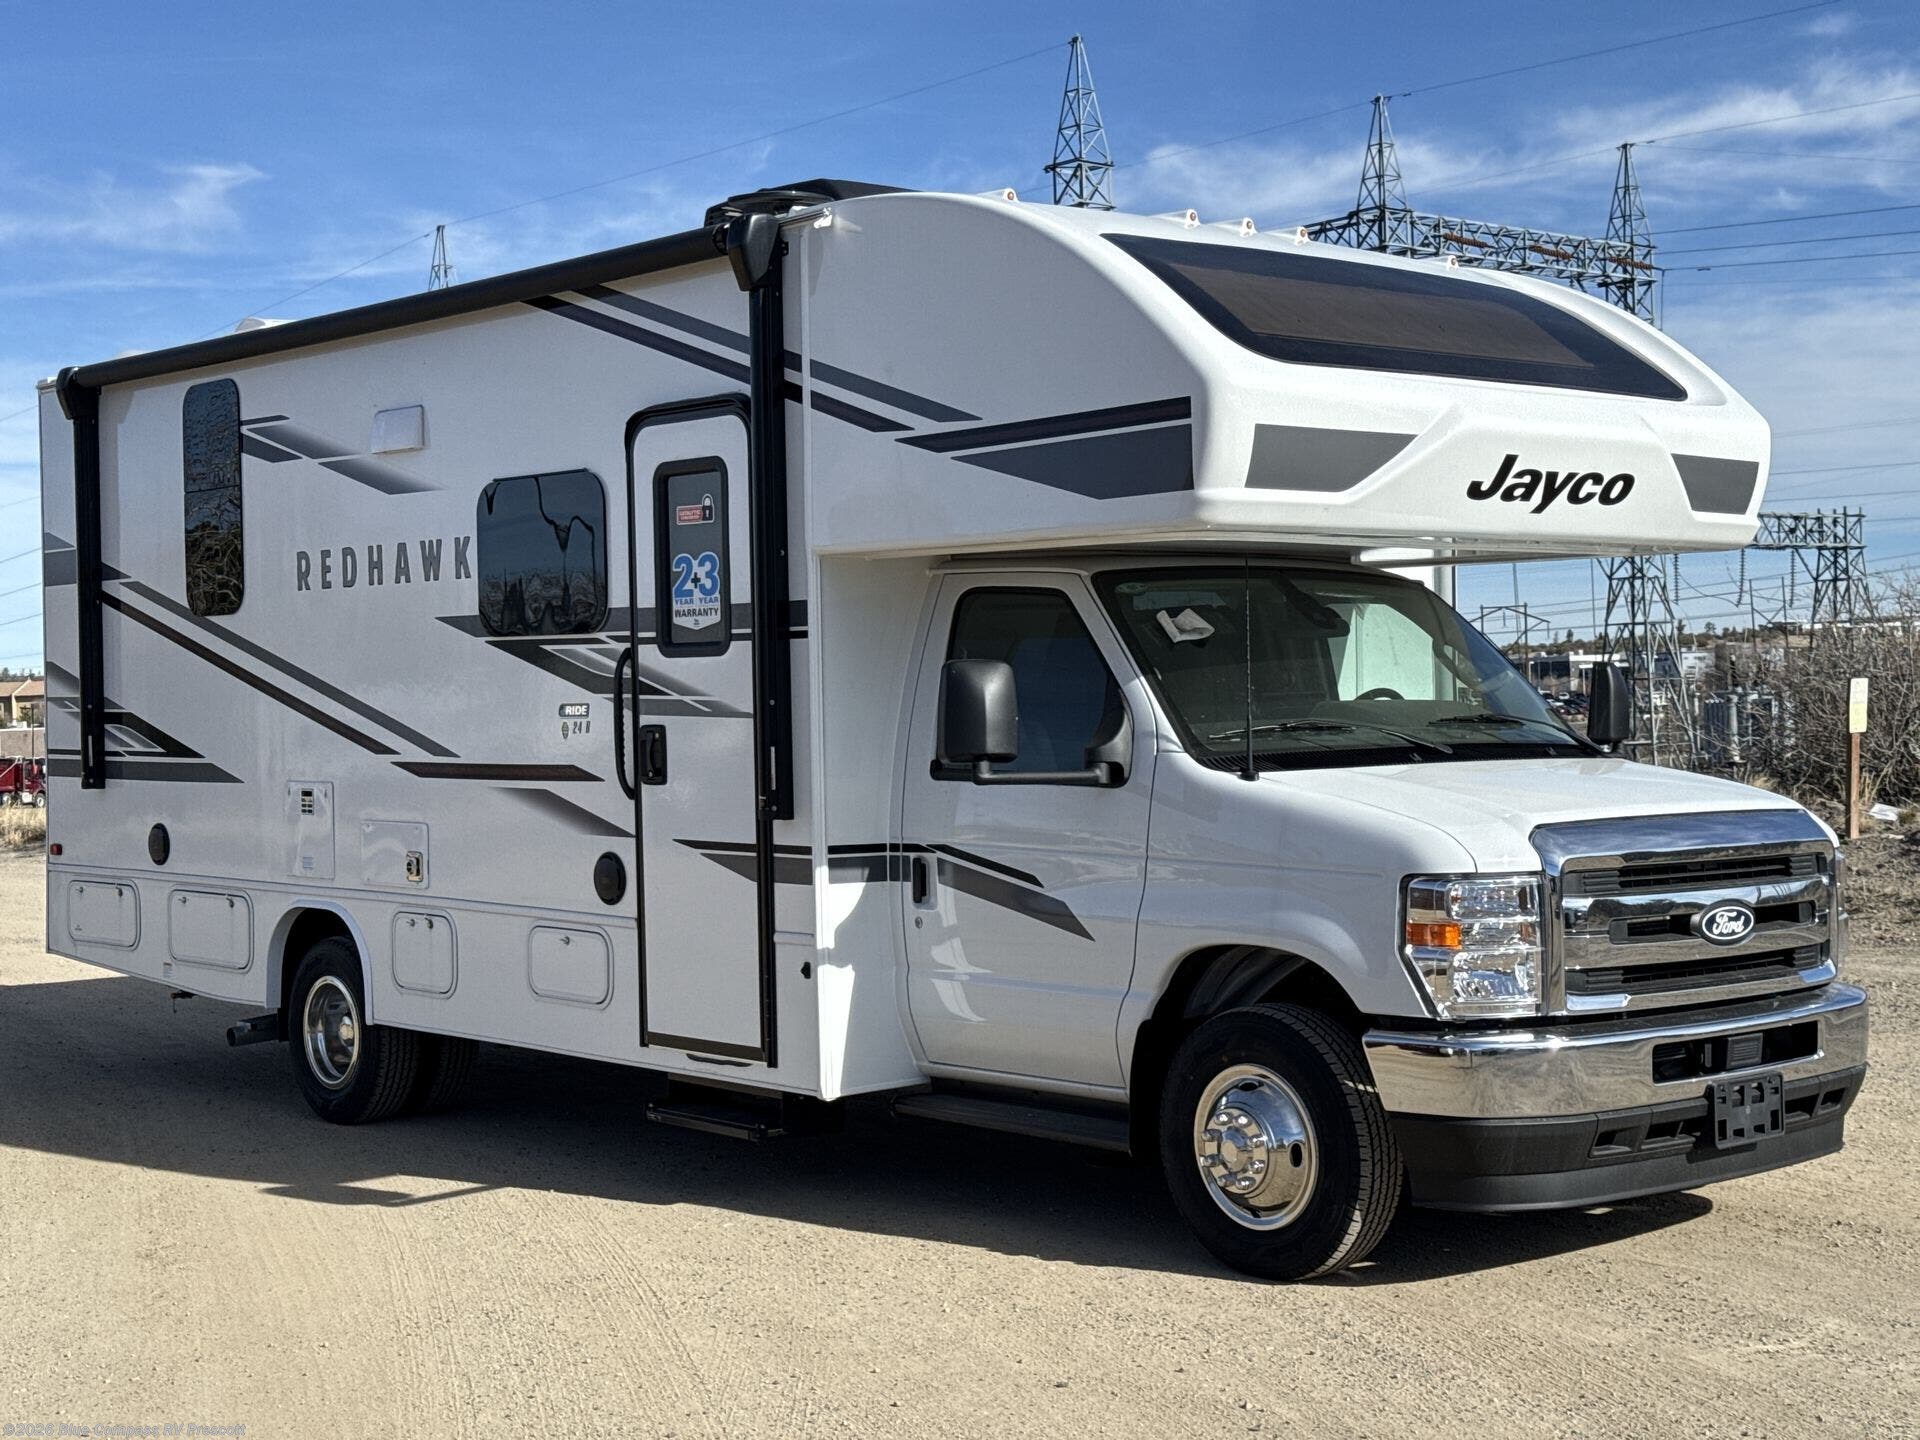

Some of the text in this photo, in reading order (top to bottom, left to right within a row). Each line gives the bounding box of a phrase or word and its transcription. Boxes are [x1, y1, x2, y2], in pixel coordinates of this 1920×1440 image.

[1466, 453, 1635, 514] Jayco
[296, 536, 471, 591] REDHAWK
[699, 596, 719, 604] YEAR
[674, 607, 719, 617] WARRANTY
[566, 705, 588, 715] RIDE
[1712, 911, 1745, 935] Ford
